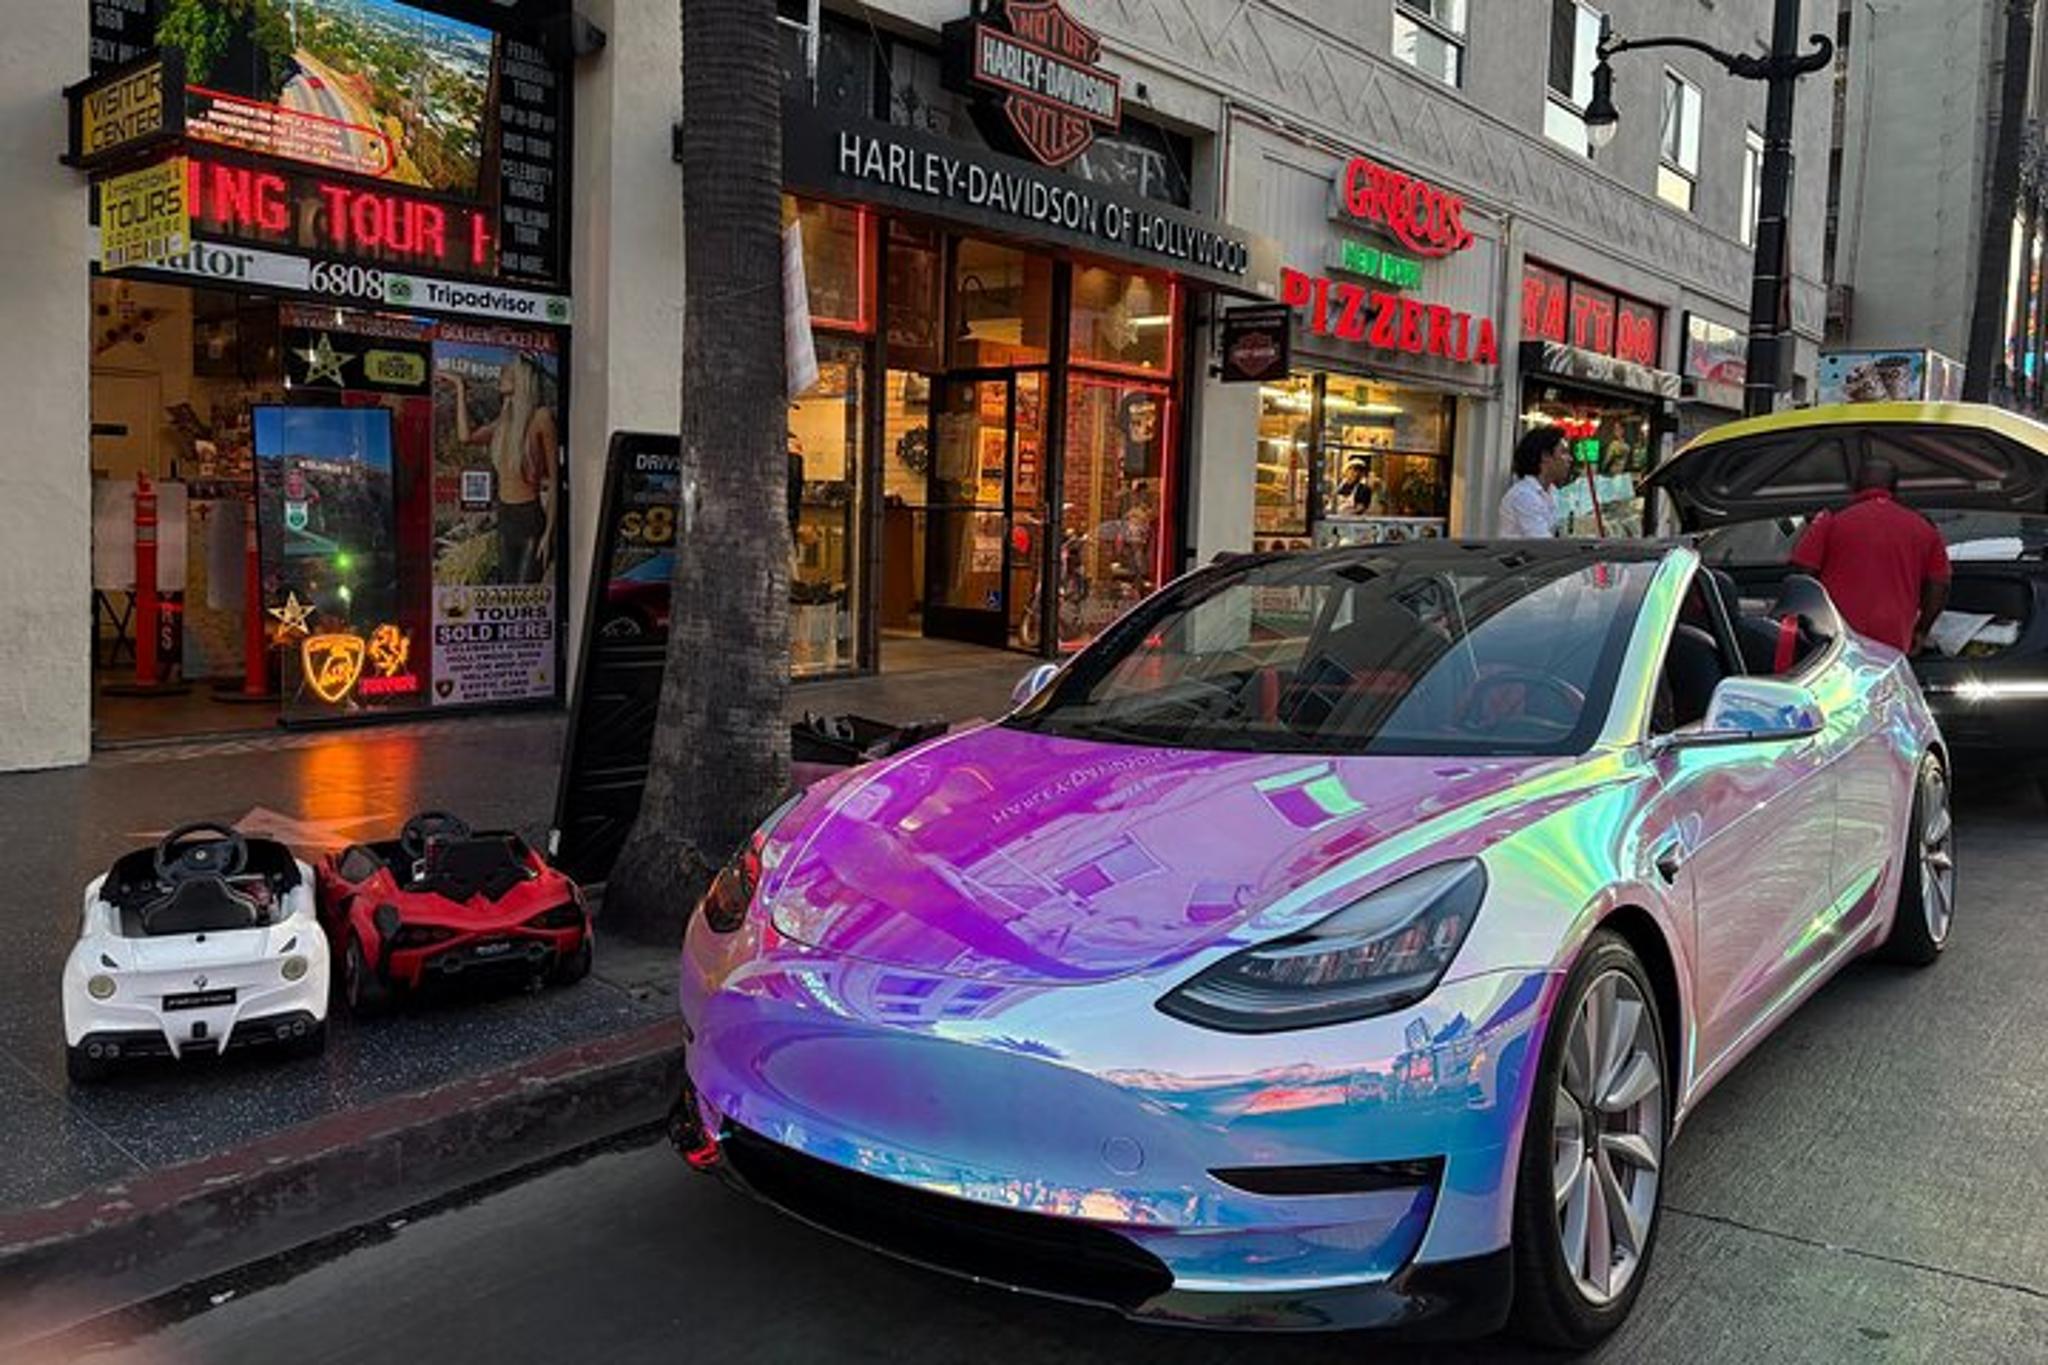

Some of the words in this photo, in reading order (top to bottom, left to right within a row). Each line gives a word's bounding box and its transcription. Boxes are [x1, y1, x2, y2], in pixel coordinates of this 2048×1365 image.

[1011, 7, 1088, 62] MOTOR
[90, 68, 163, 119] VISITOR
[983, 35, 1116, 118] HARLEY-DAVIDSON
[93, 103, 161, 148] CENTER
[1018, 98, 1084, 155] CYCLES
[106, 185, 182, 230] TOURS
[319, 182, 446, 258] TOUR
[839, 131, 1098, 234] HARLEY-DAVIDSON
[1105, 203, 1133, 242] OF
[1138, 212, 1248, 275] HOLLYWOOD
[311, 262, 384, 300] 6808
[427, 284, 536, 314] Tripadvisor
[1281, 267, 1498, 365] PIZZERIA
[1522, 277, 1656, 366] TATTOO
[636, 453, 680, 470] DRIV
[438, 624, 494, 643] SOLD
[498, 621, 549, 639] HERE
[474, 605, 548, 620] TOURS
